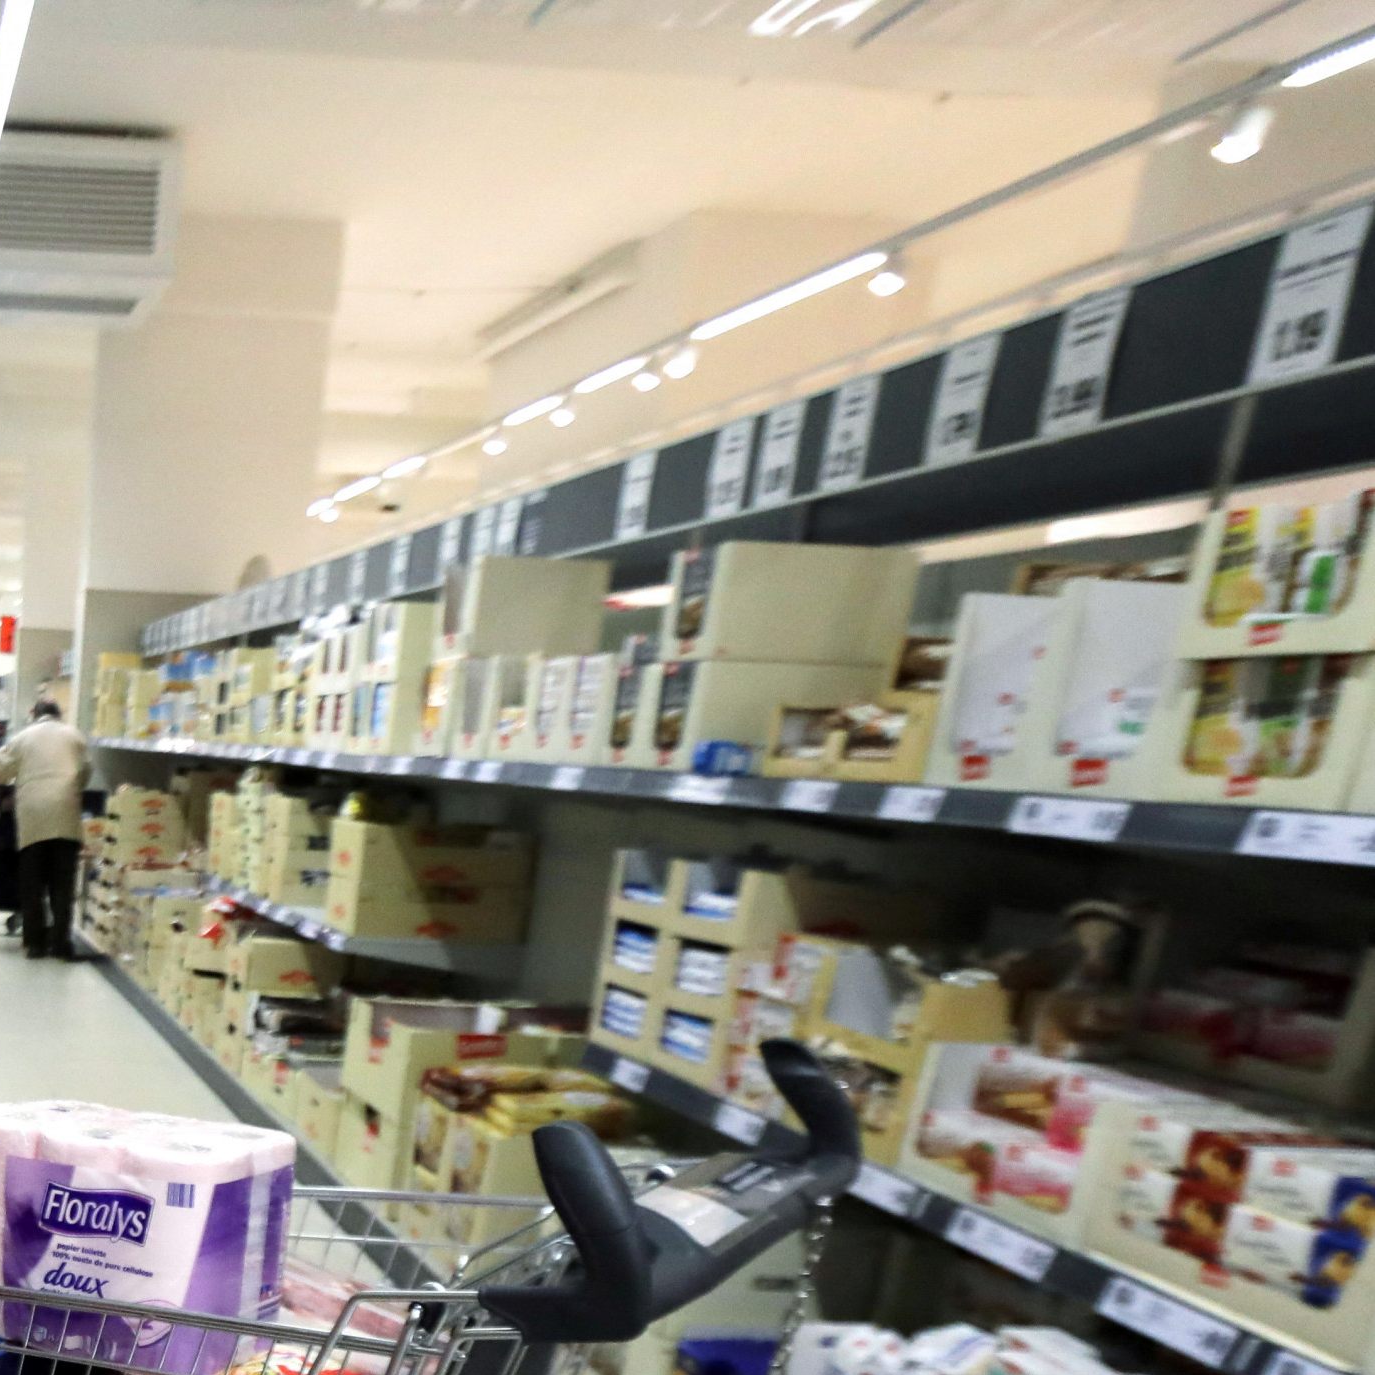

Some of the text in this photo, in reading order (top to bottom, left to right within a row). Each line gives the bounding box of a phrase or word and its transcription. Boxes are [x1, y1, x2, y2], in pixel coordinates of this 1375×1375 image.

[43, 1188, 147, 1243] Floralys
[52, 1251, 70, 1261] 100%
[94, 1258, 103, 1267] de
[104, 1262, 121, 1273] pure
[122, 1265, 154, 1278] cellulose
[56, 1242, 107, 1258] papier toilette
[43, 1261, 109, 1299] doux
